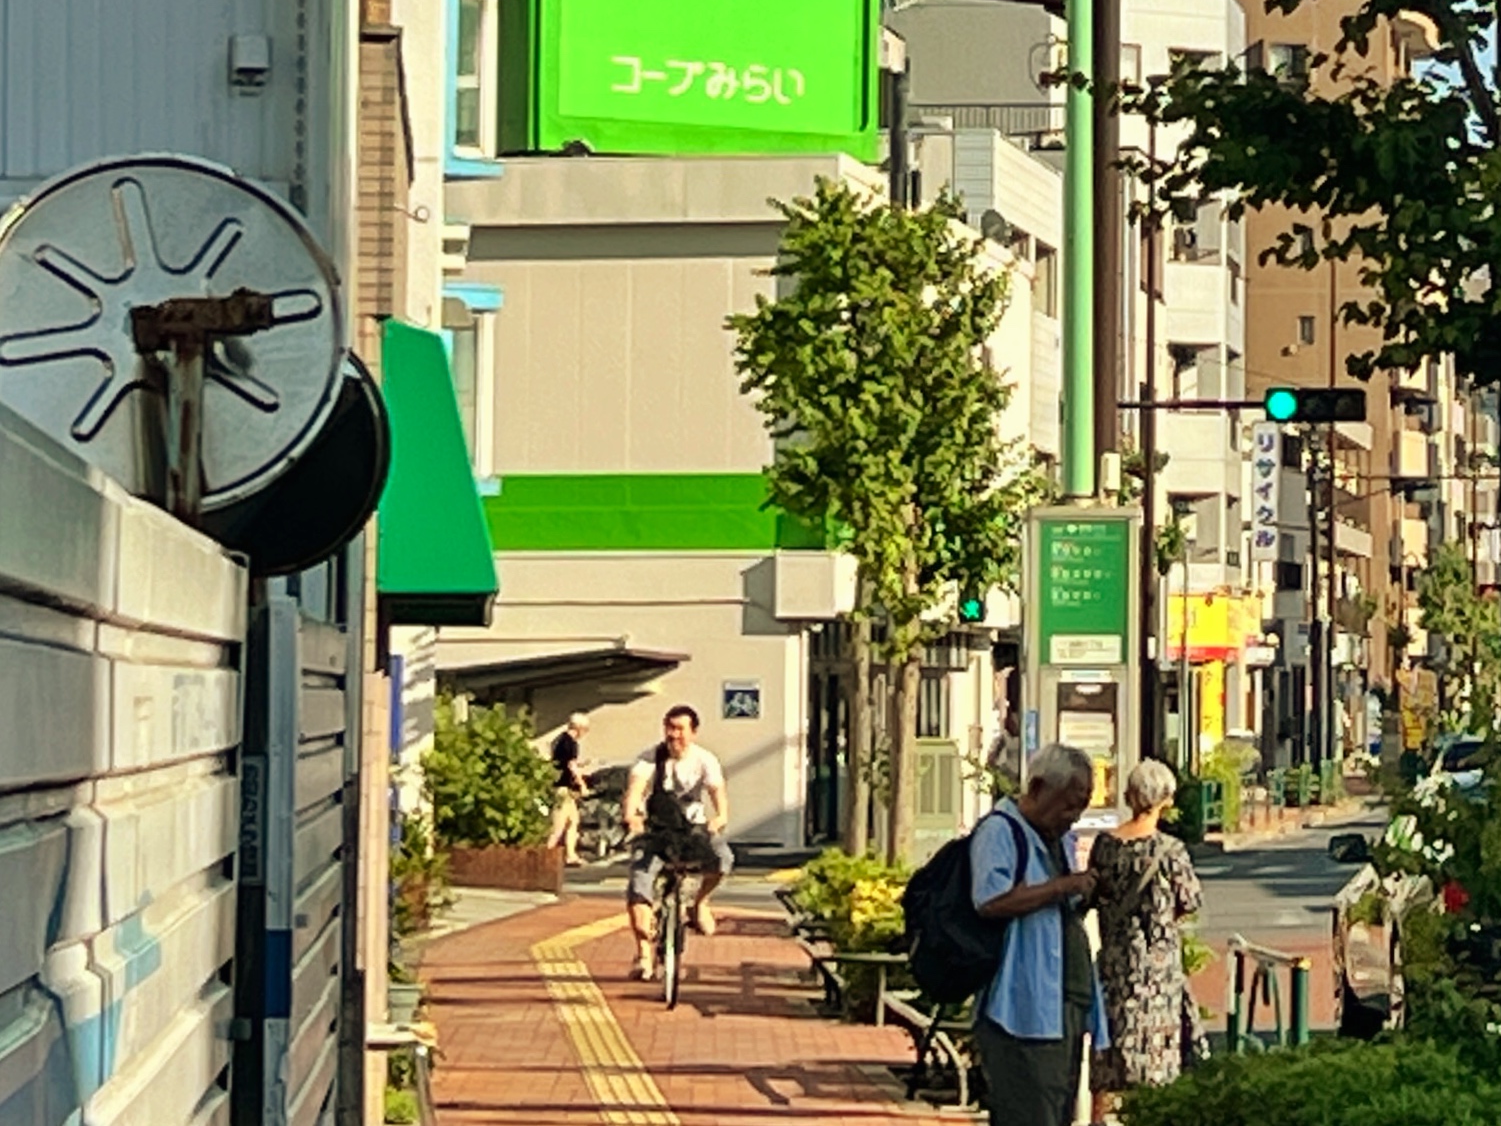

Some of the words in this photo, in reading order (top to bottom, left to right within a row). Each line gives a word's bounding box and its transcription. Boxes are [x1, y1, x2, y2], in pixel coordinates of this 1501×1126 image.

[611, 55, 805, 105] コープみらい
[1255, 432, 1276, 549] リサイクル
